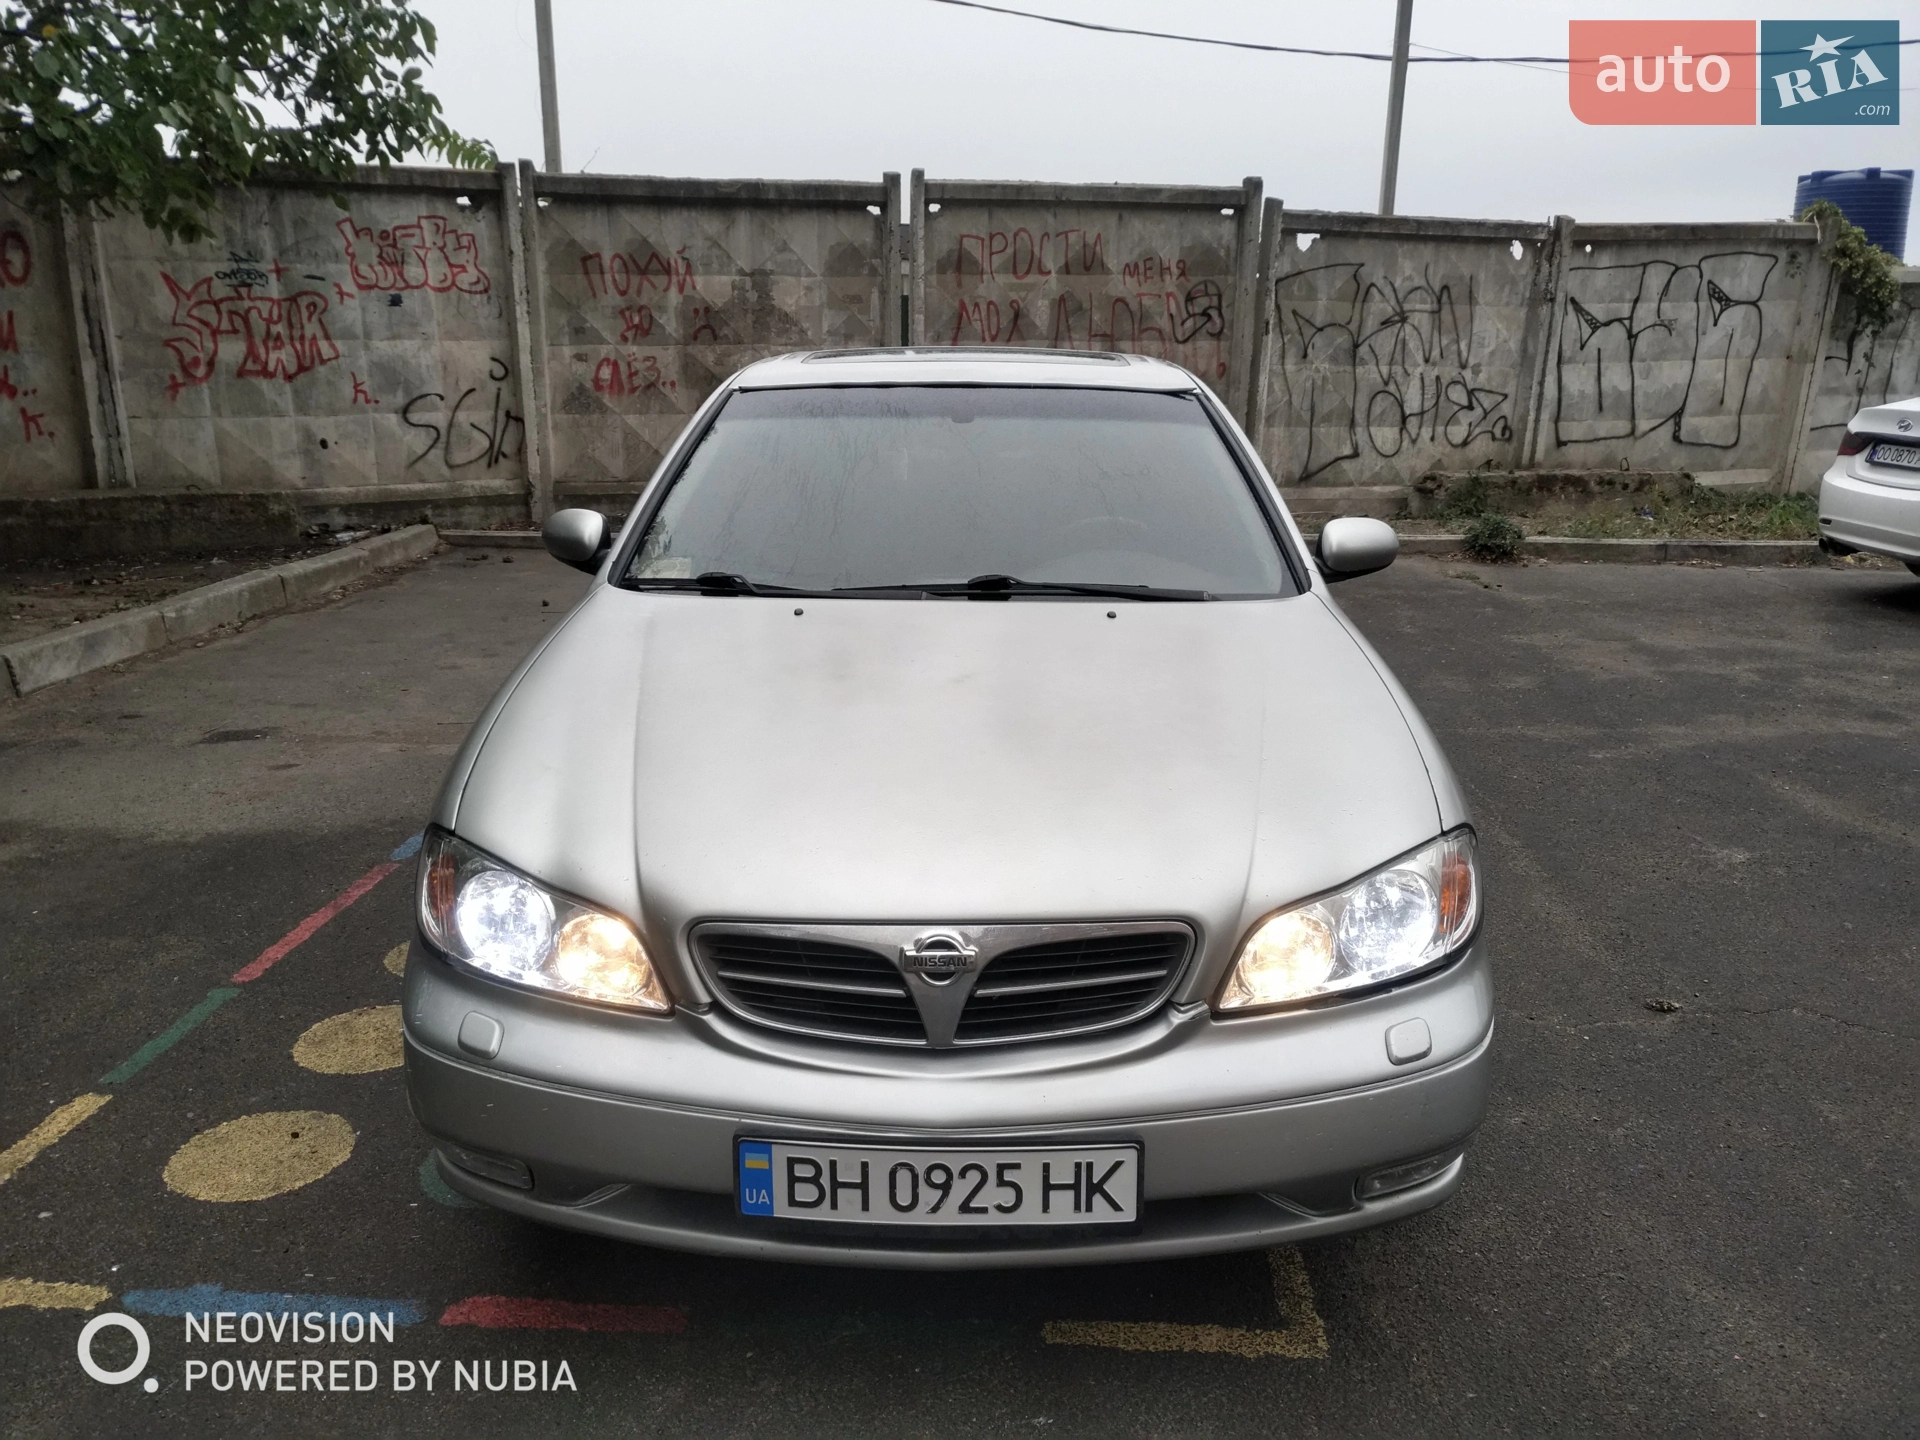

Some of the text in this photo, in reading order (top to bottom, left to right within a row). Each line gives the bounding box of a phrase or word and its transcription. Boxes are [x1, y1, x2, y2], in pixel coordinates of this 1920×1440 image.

[580, 244, 698, 299] ПОХУЙ
[955, 227, 1191, 289] ПРОСТИ МЕНЯ
[951, 299, 1025, 347] МОЯ
[913, 956, 967, 967] NISSAN
[745, 1188, 771, 1206] UA
[786, 1155, 1126, 1214] BH 0925 HK
